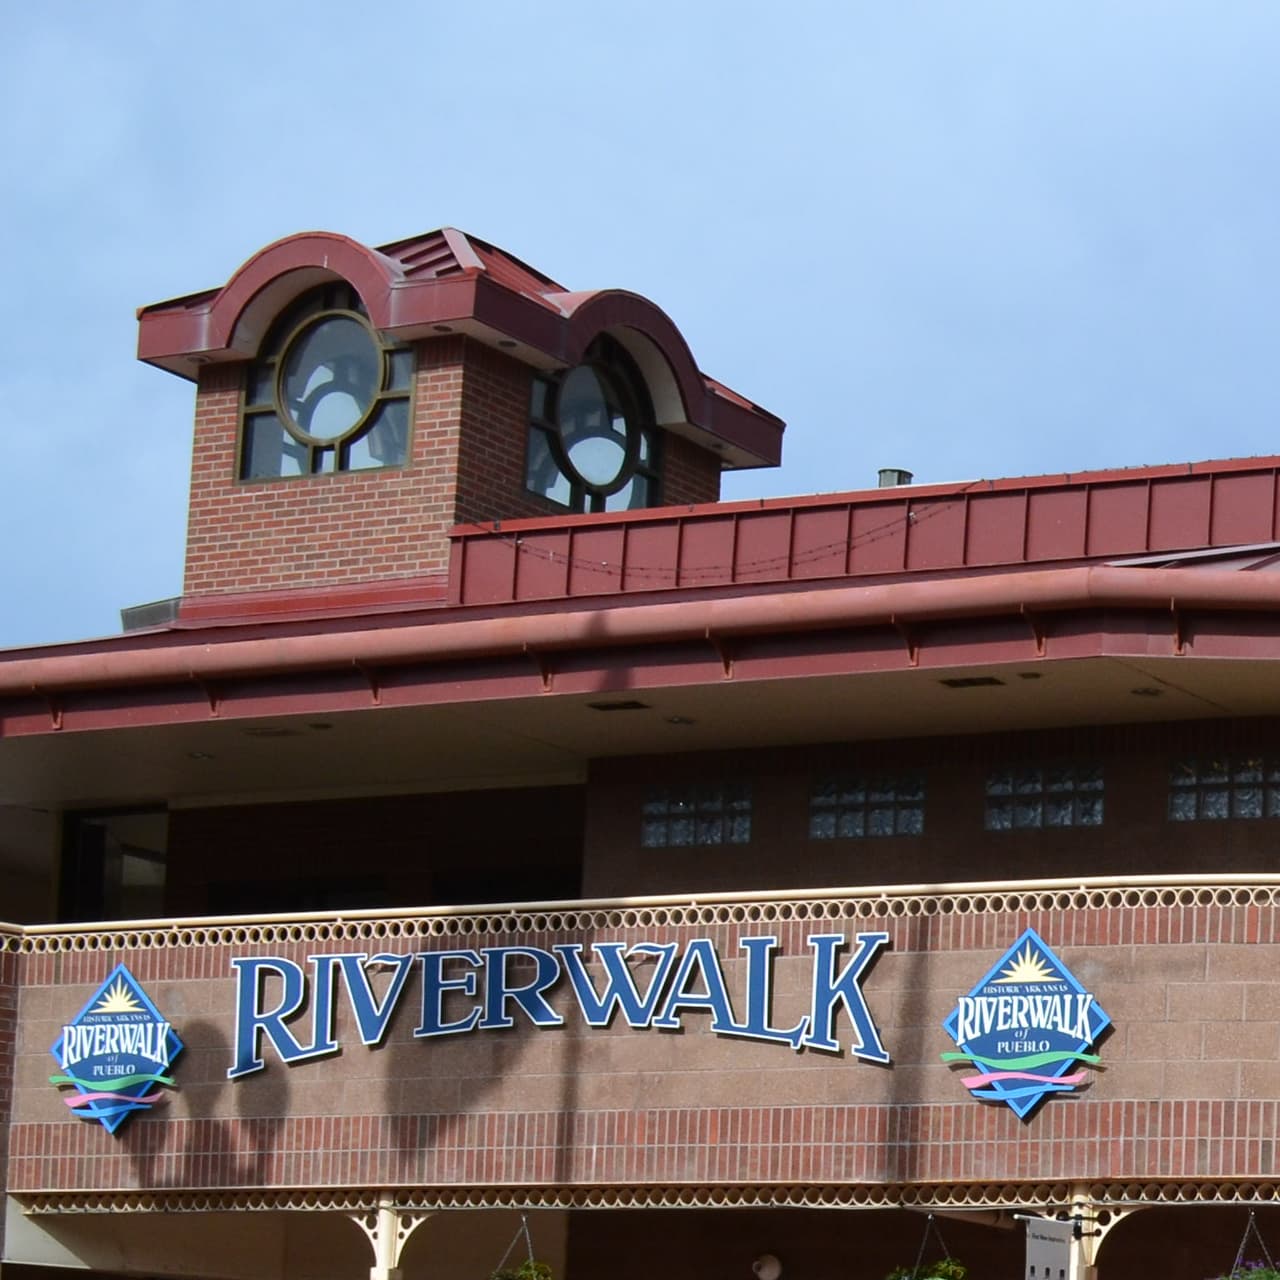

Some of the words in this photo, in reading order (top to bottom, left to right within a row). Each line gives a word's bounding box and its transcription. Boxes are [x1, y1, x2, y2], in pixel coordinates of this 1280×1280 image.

[983, 985, 1020, 994] HISTORIC
[226, 931, 891, 1079] RIVERWALK
[956, 993, 1094, 1047] RIVERWALK
[1014, 1028, 1029, 1040] of
[60, 1022, 171, 1070] RIVERWALK
[997, 1040, 1051, 1054] PUEBLO
[93, 1064, 136, 1076] PUEBLO
